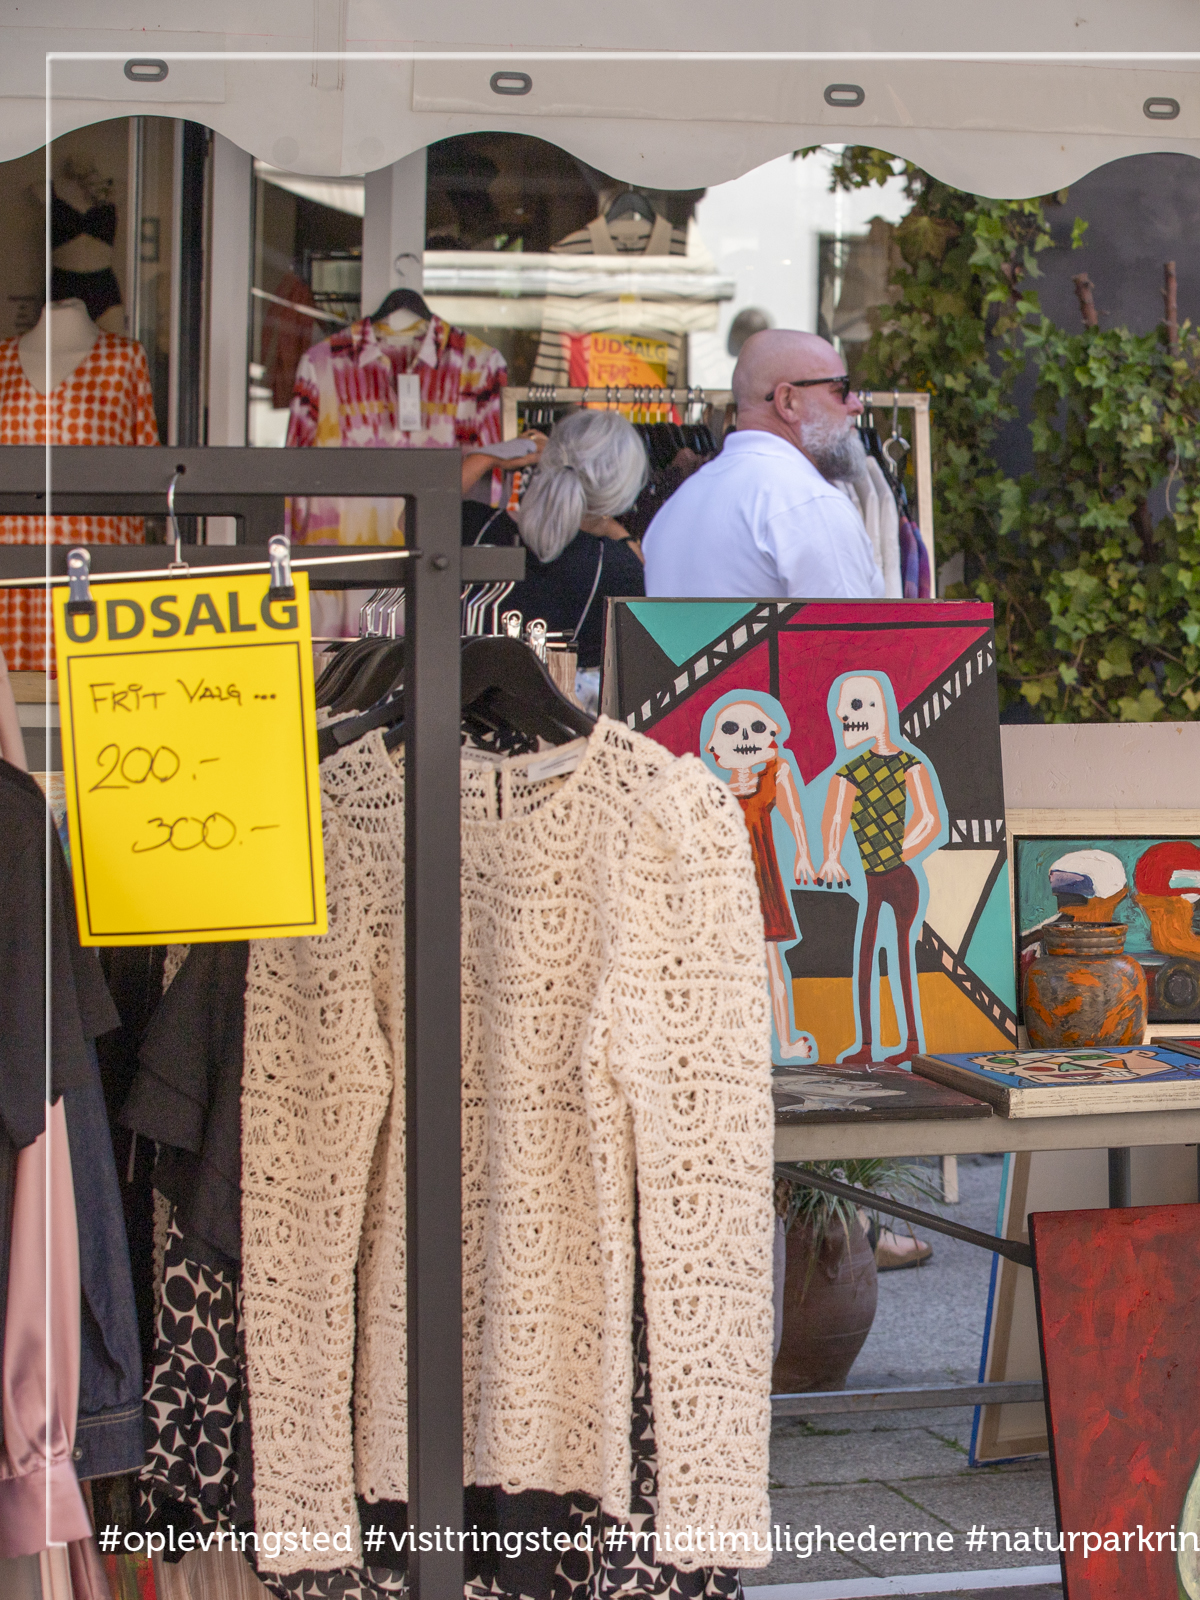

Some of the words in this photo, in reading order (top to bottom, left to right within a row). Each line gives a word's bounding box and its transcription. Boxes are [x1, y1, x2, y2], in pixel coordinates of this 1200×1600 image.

[594, 337, 666, 361] UDSALG
[64, 591, 299, 643] UDSALG
[88, 682, 167, 713] FRIT
